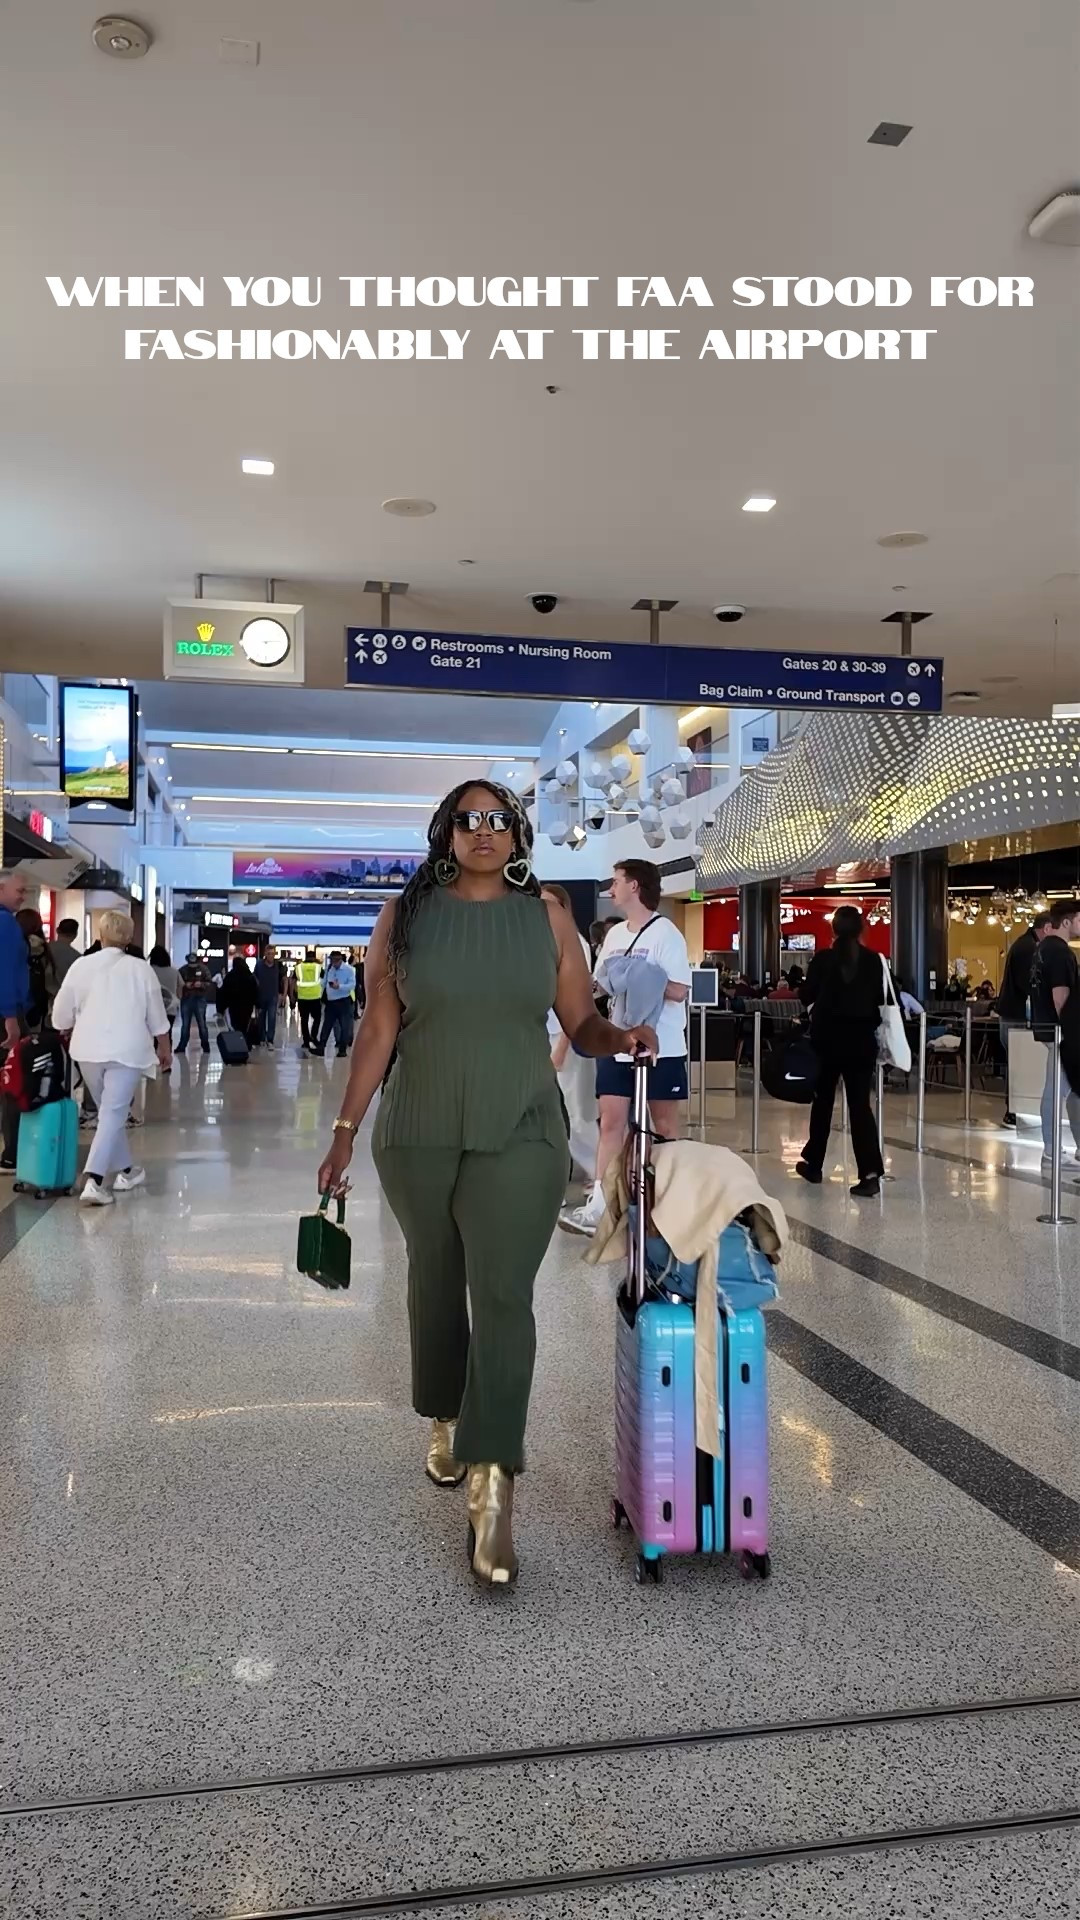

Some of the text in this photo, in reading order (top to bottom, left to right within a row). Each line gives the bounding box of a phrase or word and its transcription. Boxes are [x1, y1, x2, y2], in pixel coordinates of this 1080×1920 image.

[176, 641, 234, 656] ROLEX
[430, 638, 612, 660] Restrooms Nursing Room
[430, 655, 481, 669] Gate 21
[782, 657, 886, 674] Gates 20 & 30-39
[699, 684, 885, 705] Bag Claim Ground Transport
